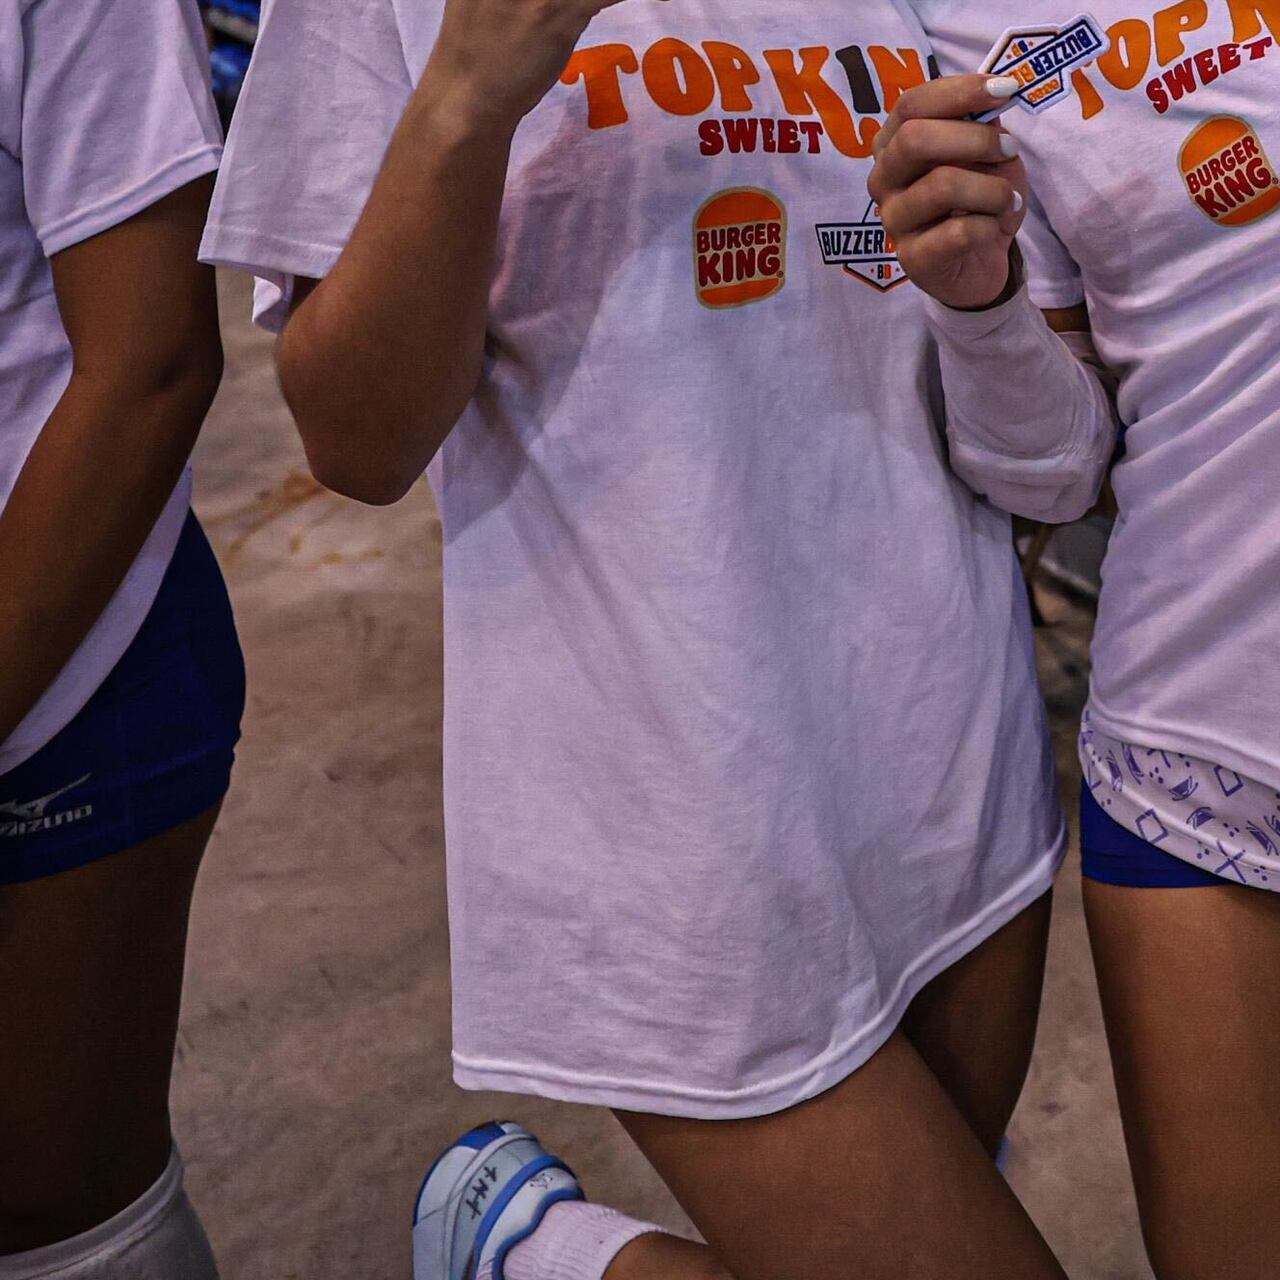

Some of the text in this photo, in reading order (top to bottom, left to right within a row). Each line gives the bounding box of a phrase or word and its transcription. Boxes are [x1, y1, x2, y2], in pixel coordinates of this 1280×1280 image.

[560, 37, 760, 130] TOP
[1146, 36, 1272, 114] SWEET
[698, 118, 824, 157] SWEET
[1185, 135, 1260, 195] BURGER
[1194, 157, 1272, 218] KING
[696, 222, 781, 254] BURGER
[698, 245, 781, 288] KING
